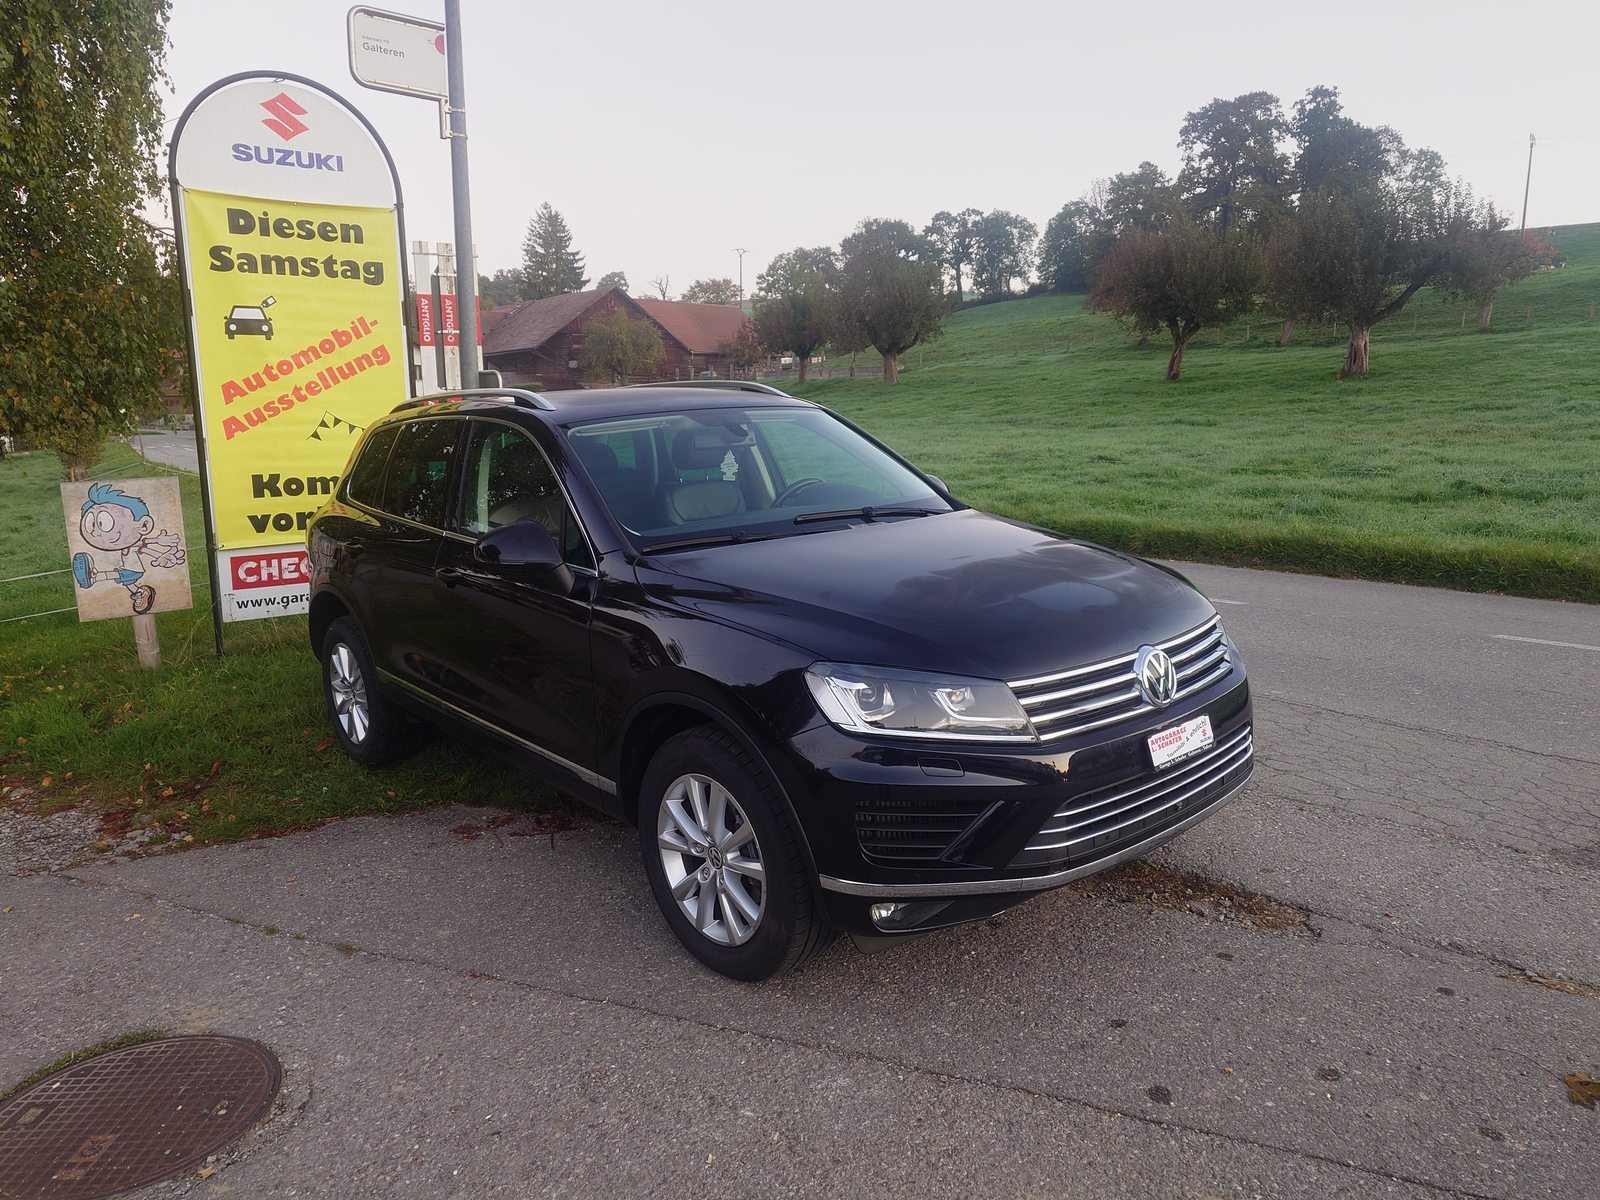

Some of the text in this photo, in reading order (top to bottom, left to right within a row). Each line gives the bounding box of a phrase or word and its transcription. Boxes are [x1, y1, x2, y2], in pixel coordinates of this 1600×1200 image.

[362, 42, 405, 58] Galteren
[231, 143, 344, 172] SUZUKI
[226, 207, 364, 244] Diesen
[208, 245, 385, 286] Samstag
[420, 297, 431, 342] ANTIGLIO
[444, 297, 455, 343] ANTIGO
[220, 316, 379, 406] Automobil-
[222, 344, 391, 441] Ausstellung
[247, 507, 320, 533] vor
[1151, 727, 1187, 746] AUTOGARAGE
